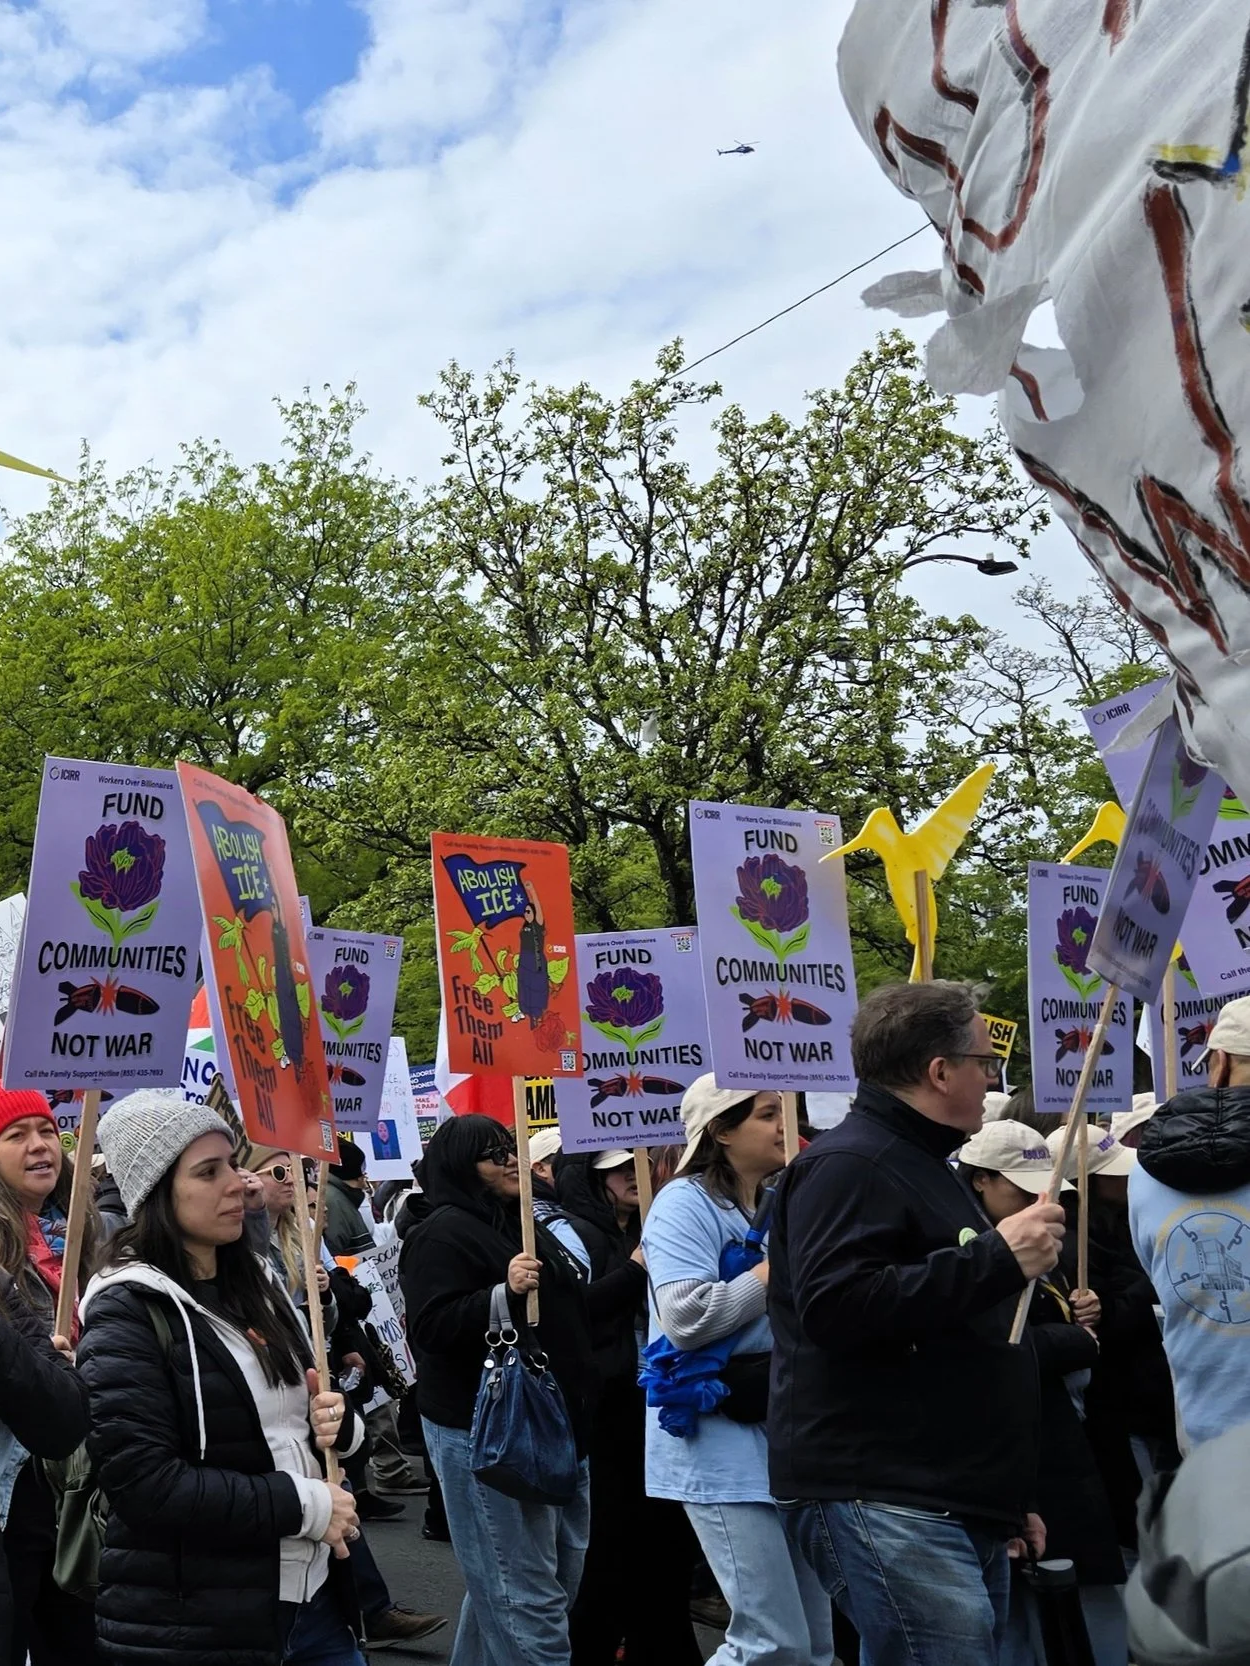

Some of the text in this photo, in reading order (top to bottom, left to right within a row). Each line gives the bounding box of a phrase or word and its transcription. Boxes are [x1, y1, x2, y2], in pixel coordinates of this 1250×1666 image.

[1106, 702, 1131, 720] ICIRR
[60, 769, 80, 781] ICIRR
[98, 775, 173, 790] Workers Over Billionaires
[101, 792, 164, 820] FUND
[704, 808, 721, 820] ICIRR
[735, 814, 802, 827] Workers Over Billionaires
[212, 823, 262, 864] ABOLISH
[744, 829, 798, 853] FUND
[231, 863, 264, 900] ICE
[457, 866, 518, 894] ABOLISH
[475, 889, 515, 917] ICE
[1062, 885, 1099, 906] FUND
[586, 940, 610, 948] Workers
[611, 939, 624, 947] Over
[1113, 906, 1158, 960] NOT WAR
[38, 940, 187, 978] COMMUNITIES
[334, 947, 369, 965] FUND
[595, 948, 651, 969] FUND
[716, 955, 846, 993] COMMUNITIES
[1220, 970, 1237, 980] Call
[451, 974, 494, 1016] Free
[225, 985, 266, 1054] Free
[454, 1005, 503, 1041] Them
[51, 1032, 152, 1057] NOT WAR
[324, 1040, 382, 1064] MUNITIES
[472, 1038, 494, 1067] All
[744, 1037, 833, 1062] NOT WAR
[233, 1033, 277, 1093] Them
[582, 1044, 702, 1071] OMMUNITIES
[24, 1070, 38, 1078] Call
[38, 1070, 49, 1078] the
[50, 1070, 70, 1079] Family
[72, 1070, 97, 1079] Support
[183, 1056, 216, 1086] NO
[749, 1072, 766, 1080] Family
[1056, 1067, 1080, 1087] NOT
[255, 1085, 276, 1133] All
[334, 1096, 362, 1112] WAR
[592, 1111, 634, 1128] NOT
[597, 1136, 615, 1144] Family
[616, 1134, 638, 1142] Support
